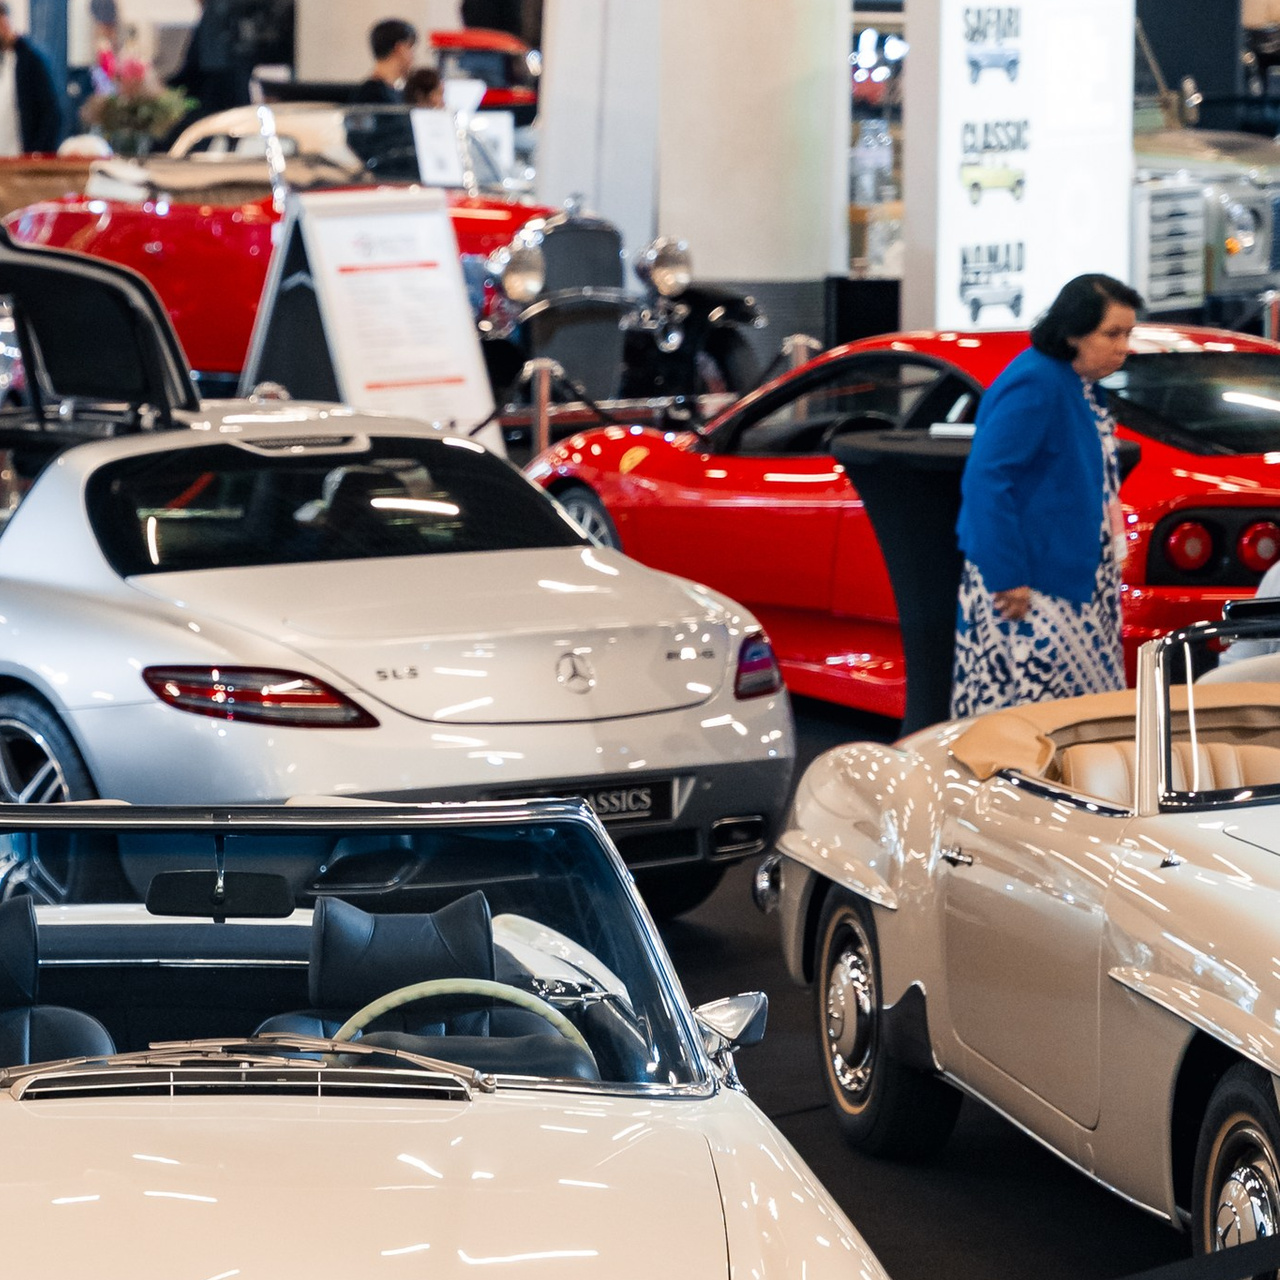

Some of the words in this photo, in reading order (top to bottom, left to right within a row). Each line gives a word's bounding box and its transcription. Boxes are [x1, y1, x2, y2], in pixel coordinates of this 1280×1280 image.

[963, 6, 1022, 42] SAFARI
[962, 119, 1030, 153] CLASSIC
[961, 242, 1024, 273] NOMAD
[580, 786, 652, 815] ASSICS
